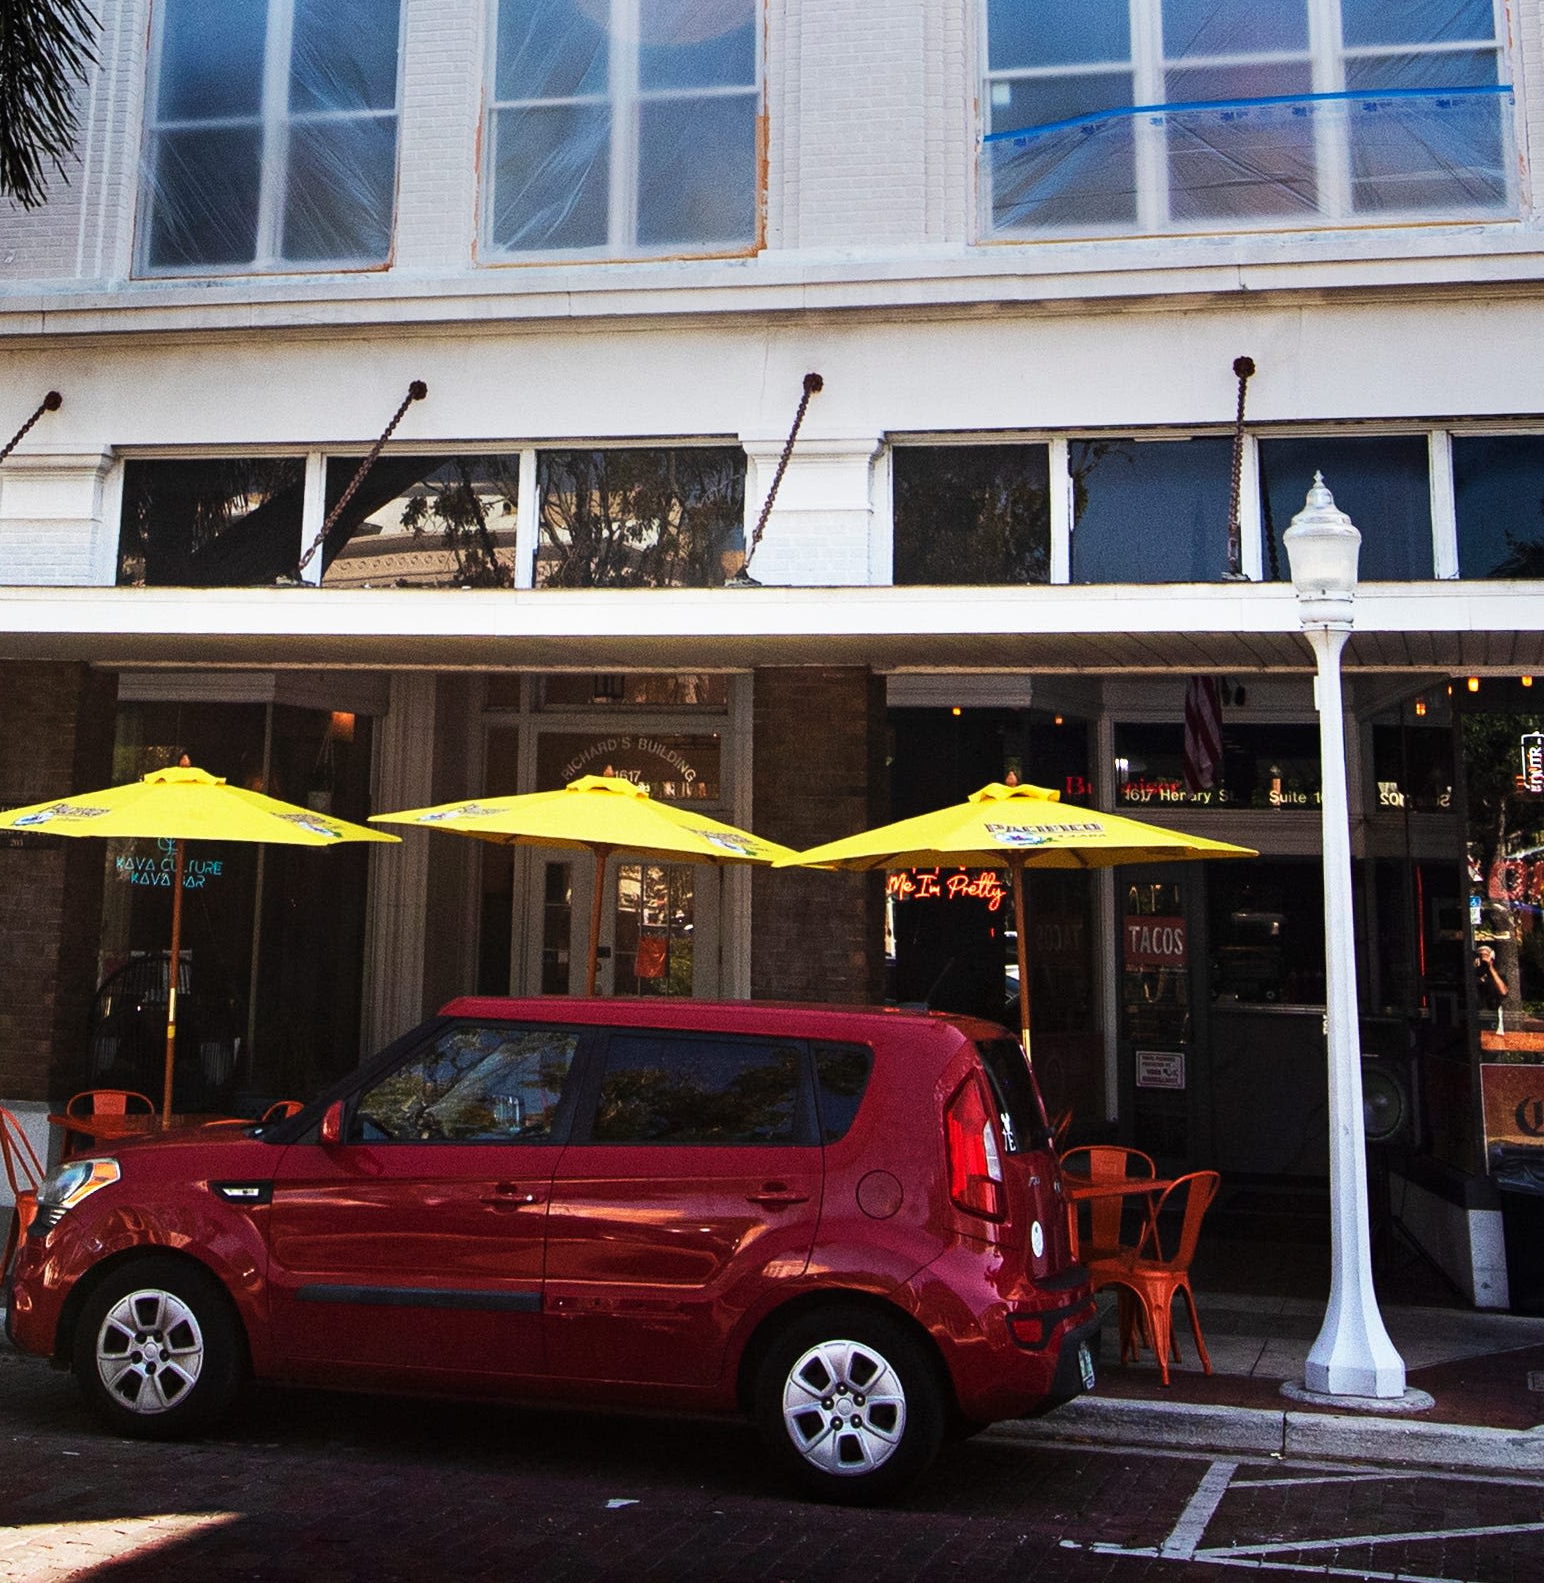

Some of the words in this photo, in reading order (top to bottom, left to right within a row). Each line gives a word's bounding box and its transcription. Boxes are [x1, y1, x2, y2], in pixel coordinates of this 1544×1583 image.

[561, 736, 632, 780] RICHARD'S
[638, 738, 696, 783] BUILDING
[614, 769, 641, 783] 1617
[1269, 790, 1307, 804] Suite
[116, 856, 156, 871] KAVA
[131, 870, 172, 886] KAVA
[182, 874, 206, 888] AR
[886, 872, 916, 900] Me
[947, 871, 1007, 912] Pretty
[1128, 925, 1185, 955] TACOS
